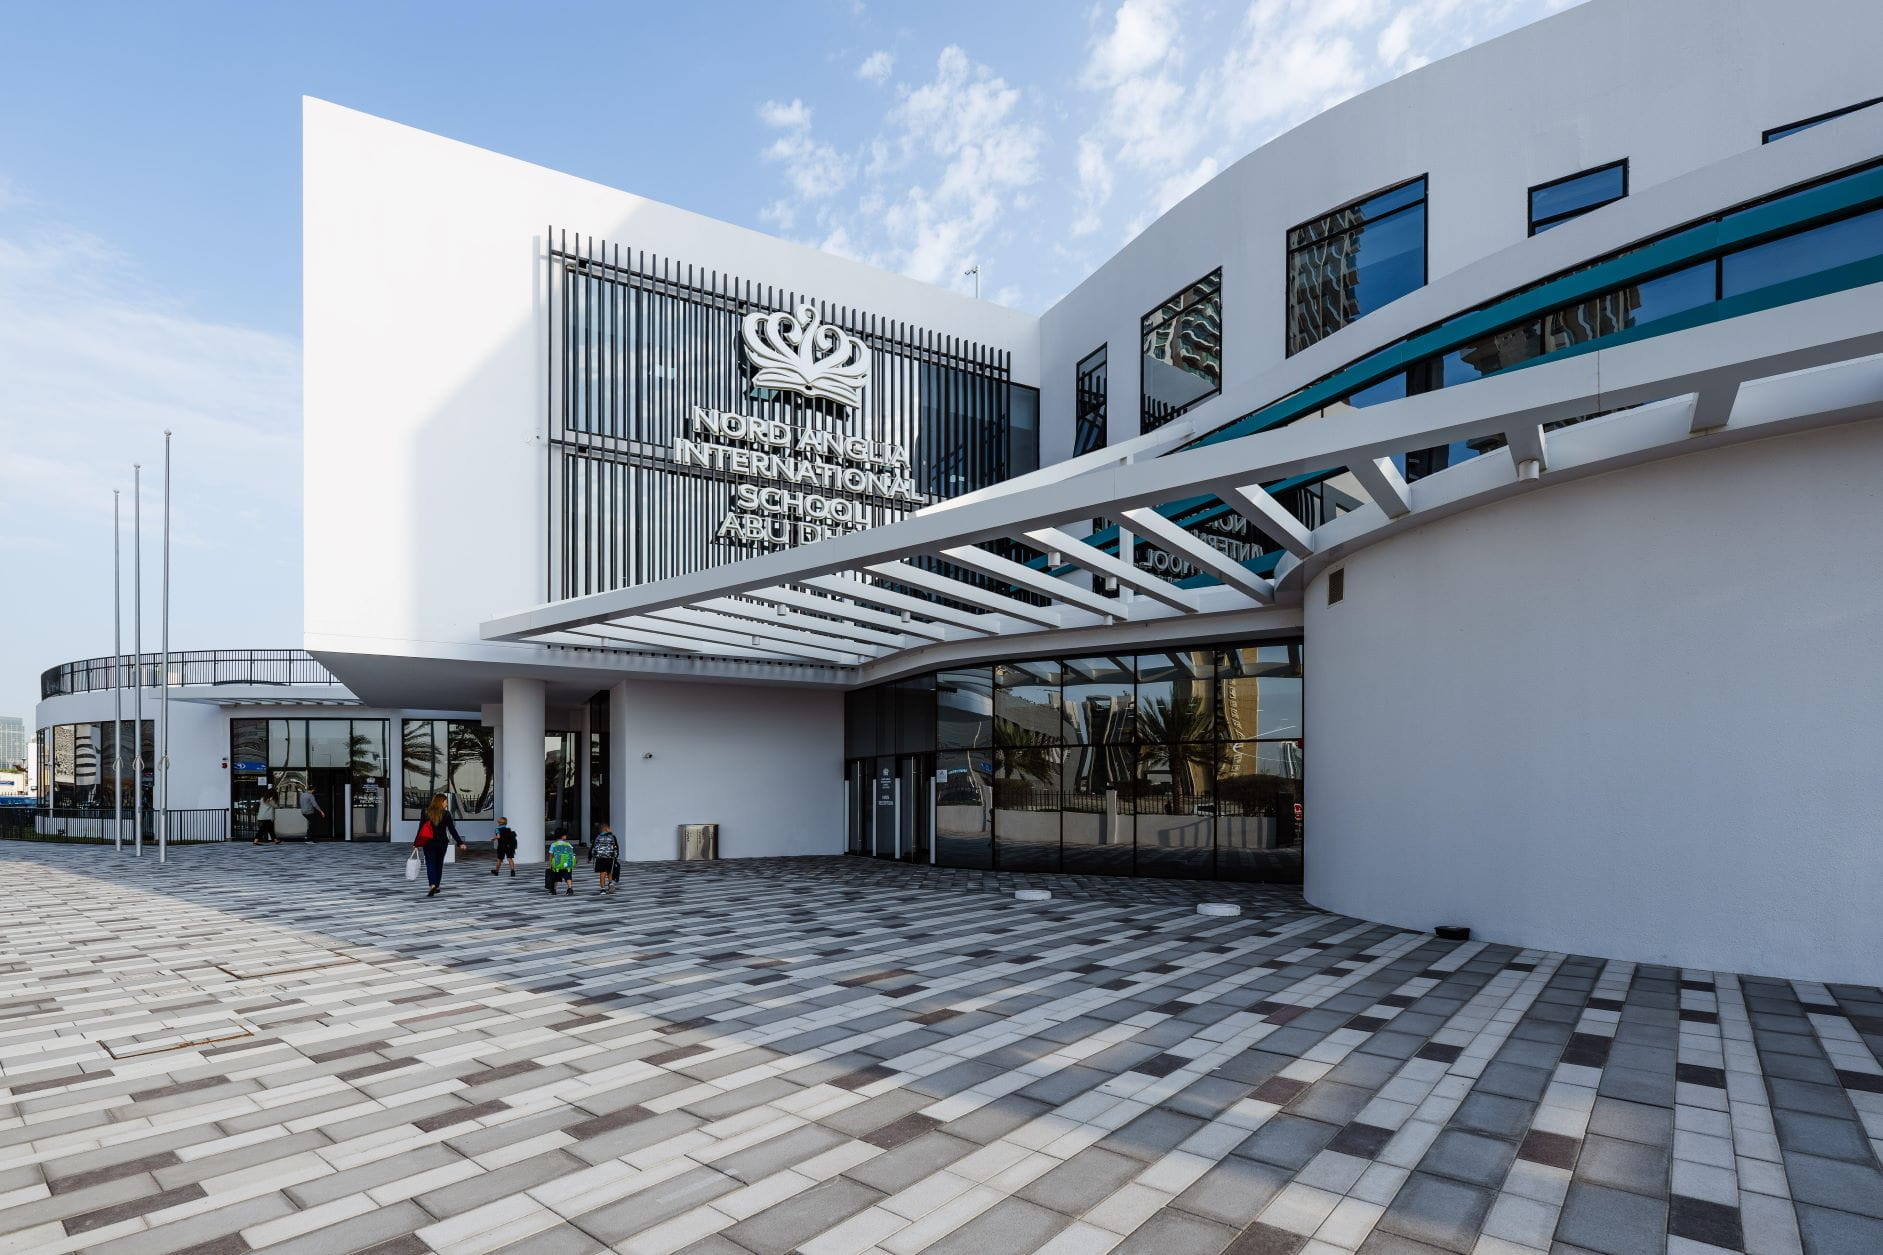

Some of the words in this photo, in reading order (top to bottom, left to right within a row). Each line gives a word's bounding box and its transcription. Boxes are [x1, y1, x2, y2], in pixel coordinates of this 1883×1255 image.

[693, 406, 792, 447] NORD
[796, 426, 911, 470] ANGLIA
[673, 437, 924, 503] INTERNATIONAL
[717, 512, 790, 544] ABU
[737, 484, 870, 525] SCHOOL
